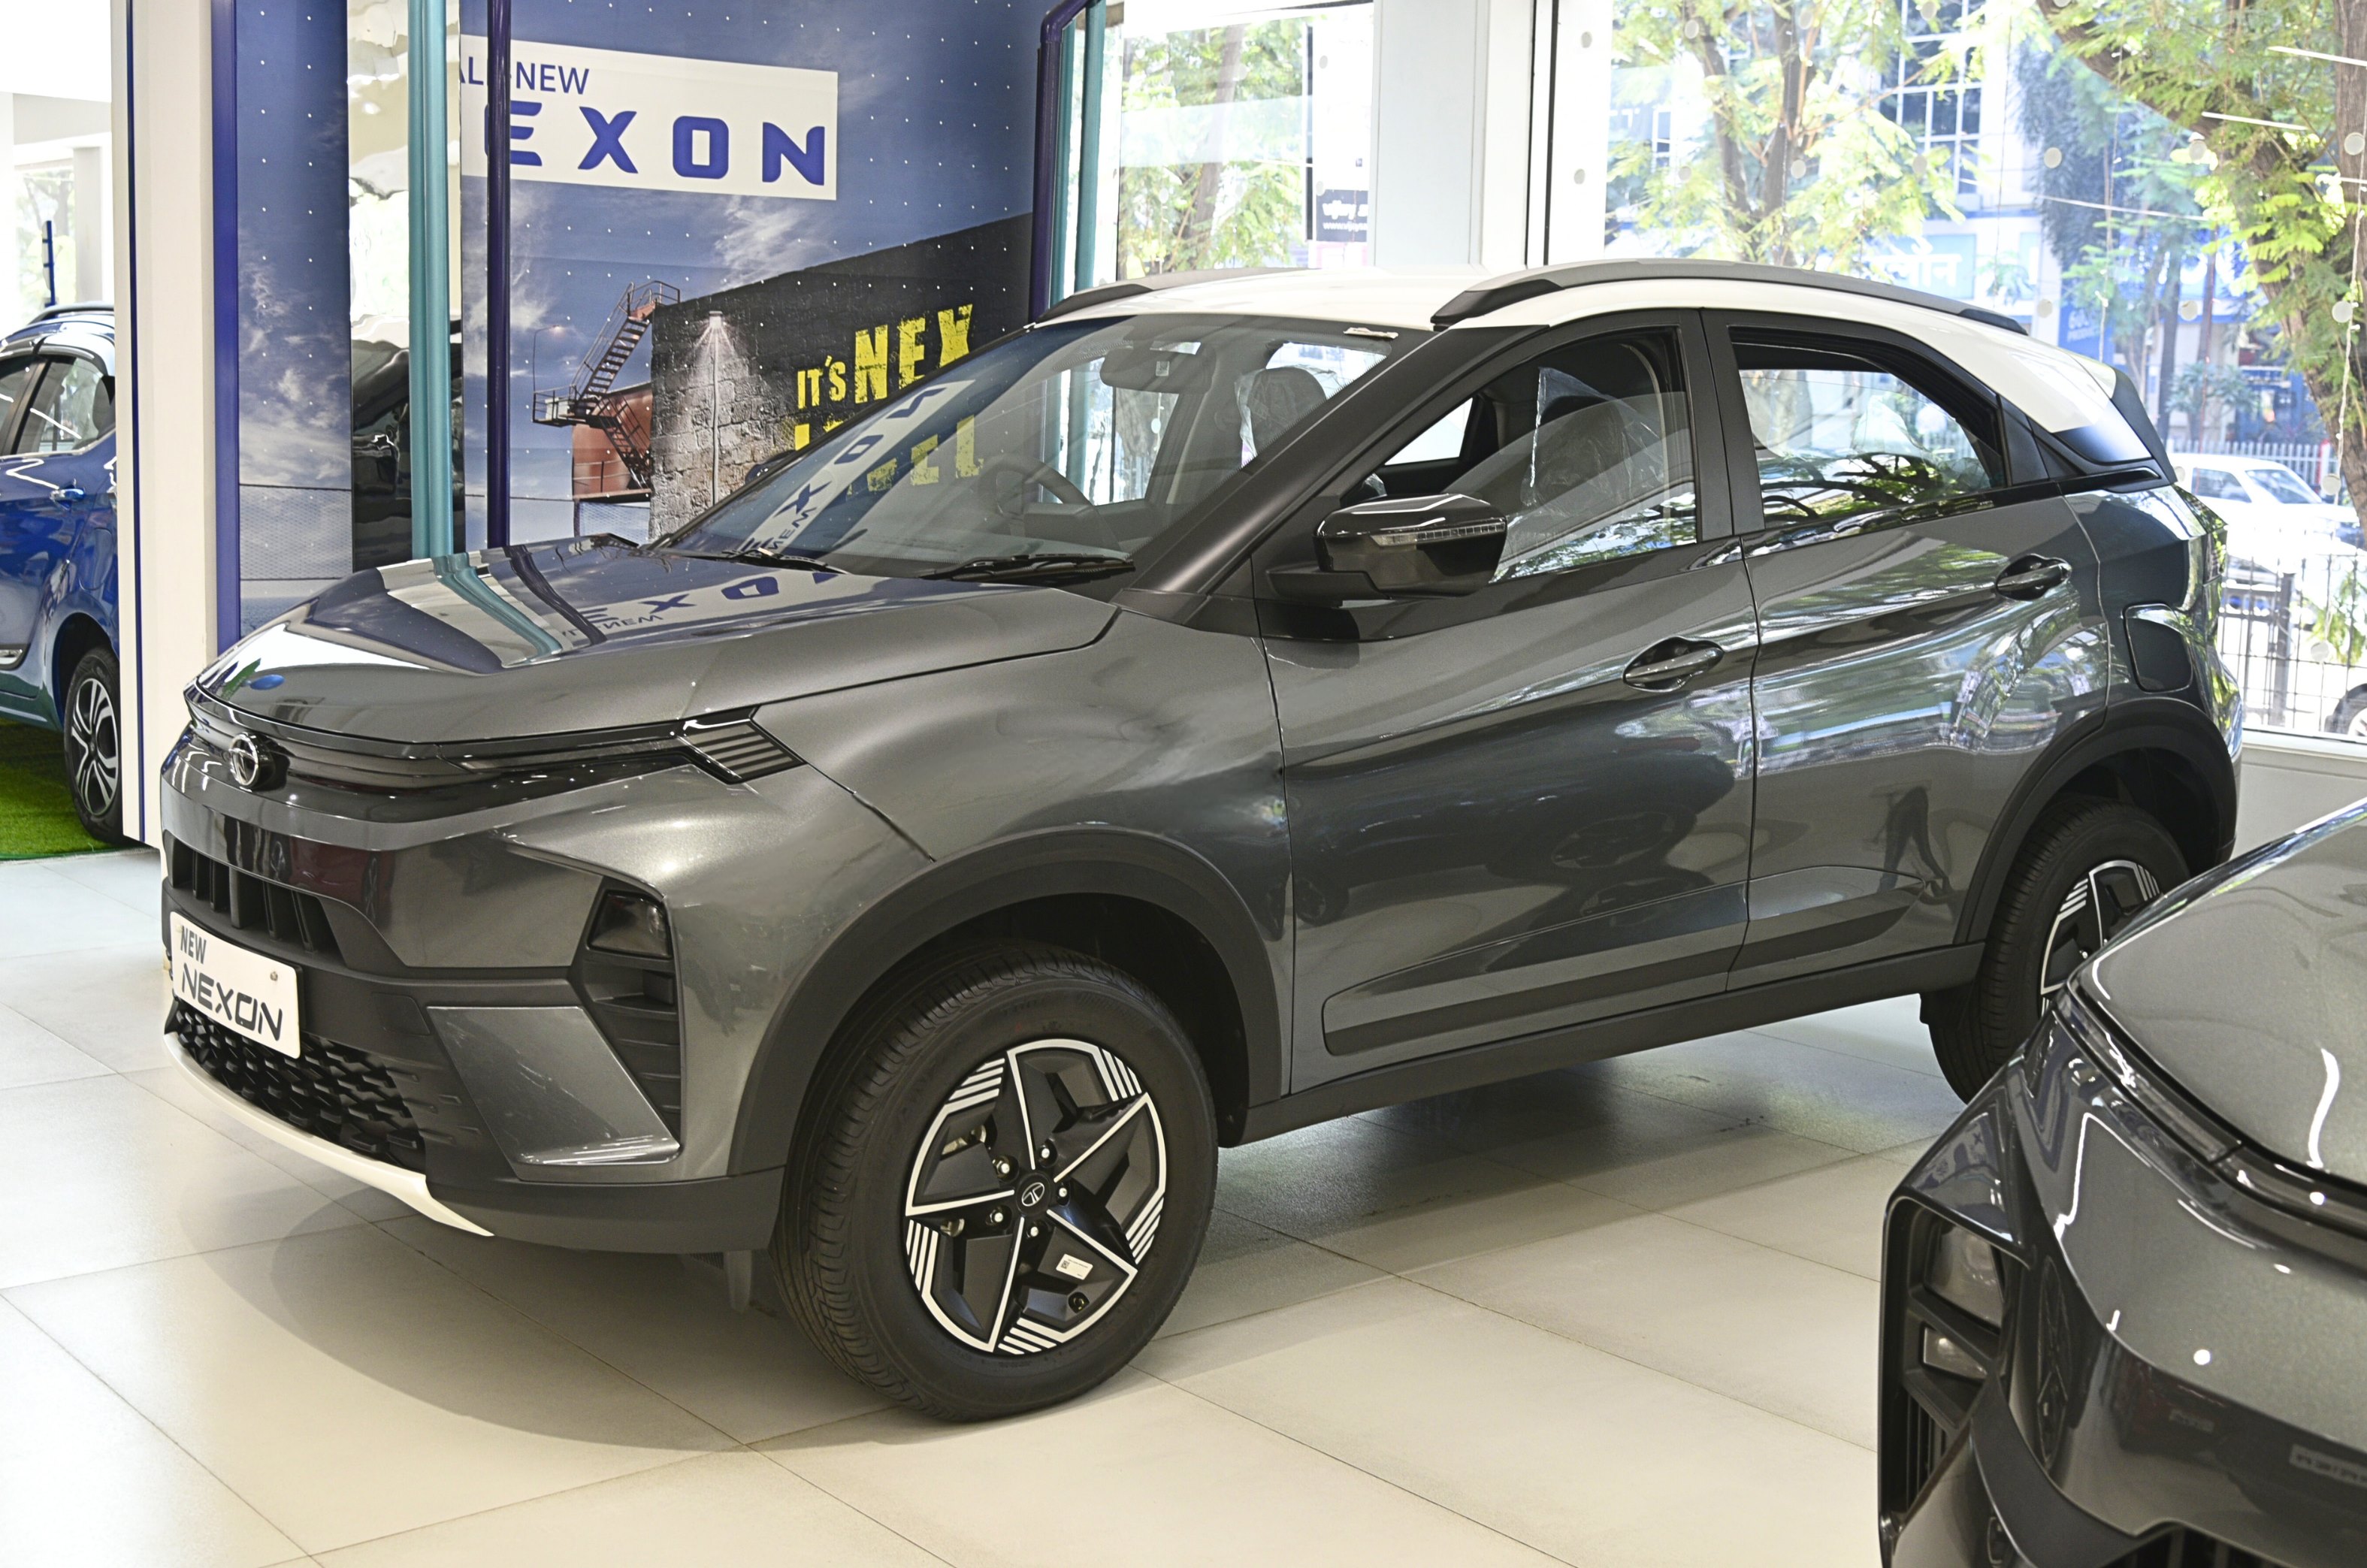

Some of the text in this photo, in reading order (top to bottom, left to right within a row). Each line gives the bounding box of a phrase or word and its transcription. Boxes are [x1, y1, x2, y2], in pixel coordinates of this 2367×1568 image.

[485, 100, 825, 186] EXON
[797, 355, 846, 409] IT'S
[180, 925, 207, 964] NEW
[182, 962, 283, 1041] NEXON
